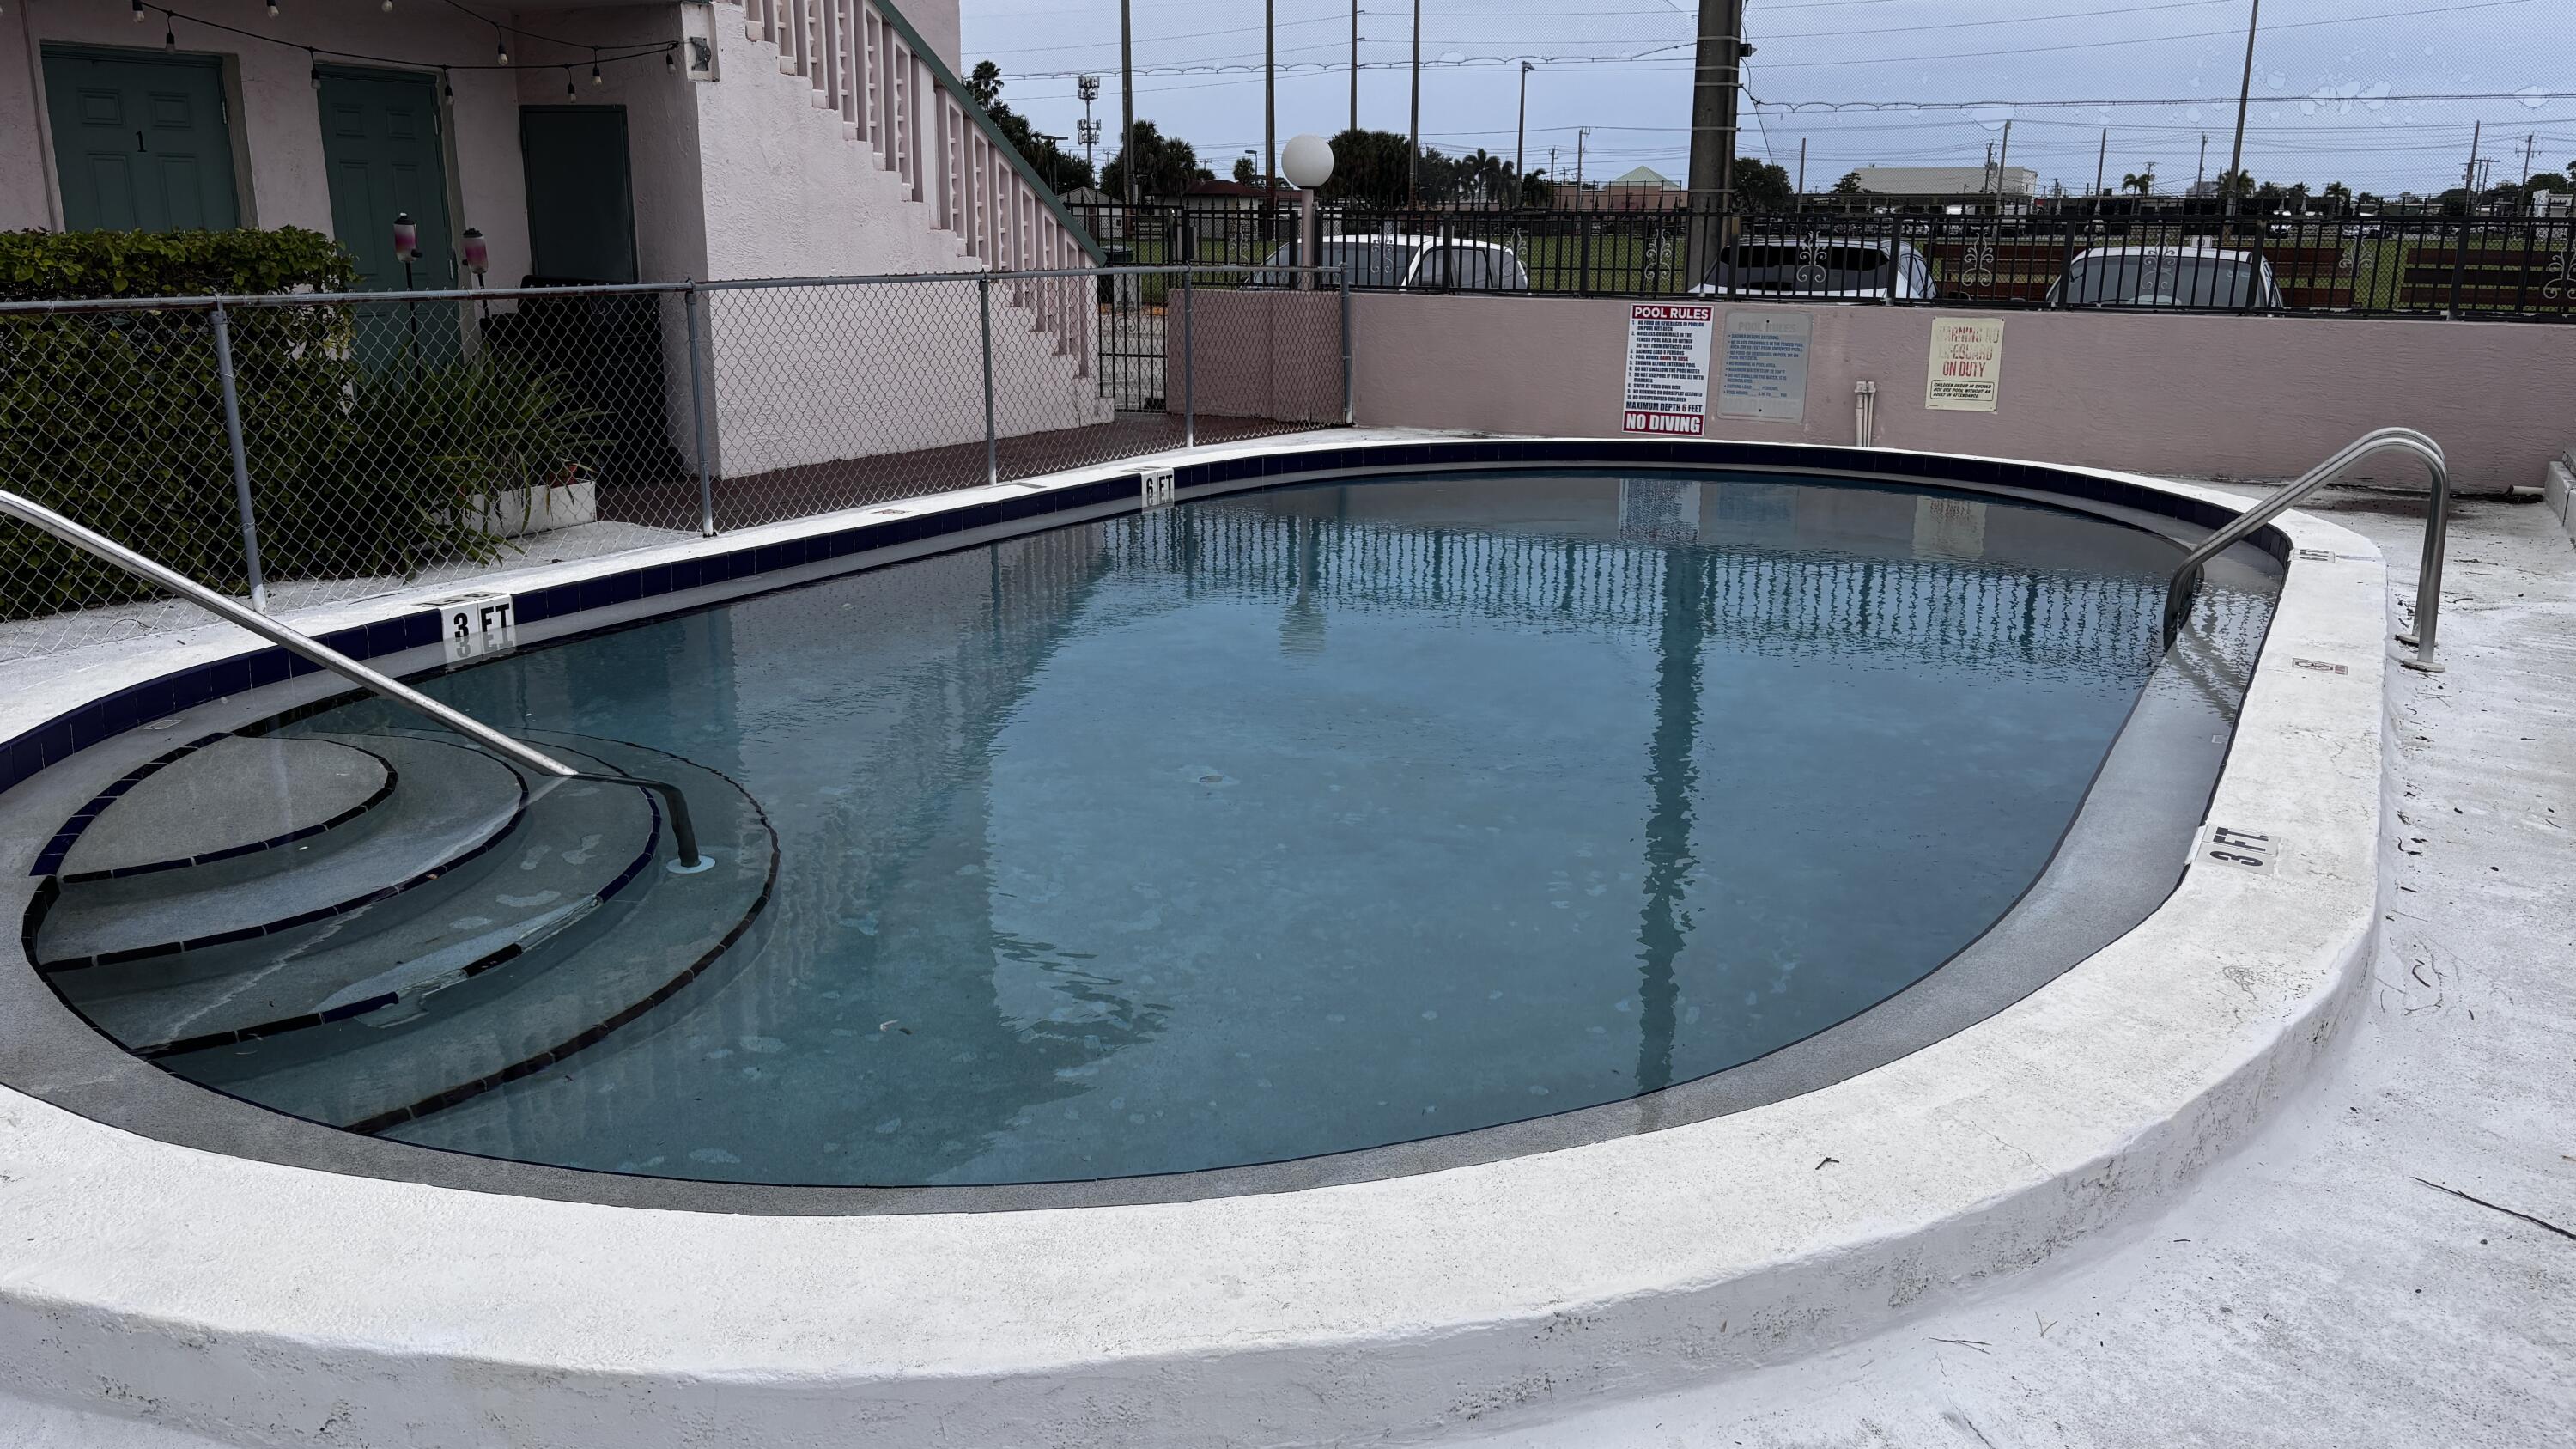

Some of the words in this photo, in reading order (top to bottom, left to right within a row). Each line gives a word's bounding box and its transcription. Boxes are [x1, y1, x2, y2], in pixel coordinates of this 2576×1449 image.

[136, 131, 147, 152] 1
[1635, 307, 1667, 318] POOL
[1670, 308, 1709, 319] RULES
[1942, 361, 1957, 376] ON
[1959, 361, 1986, 377] DUTY
[1626, 401, 1659, 411] MAXIMUM
[1660, 403, 1680, 411] DEPTH
[1626, 413, 1646, 429] NO
[1649, 414, 1701, 433] DIVING
[1146, 478, 1153, 493] 6
[1159, 474, 1172, 491] FT
[453, 612, 469, 637] 3
[481, 603, 509, 632] FT
[2213, 827, 2269, 851] FT
[2209, 850, 2263, 867] 3
